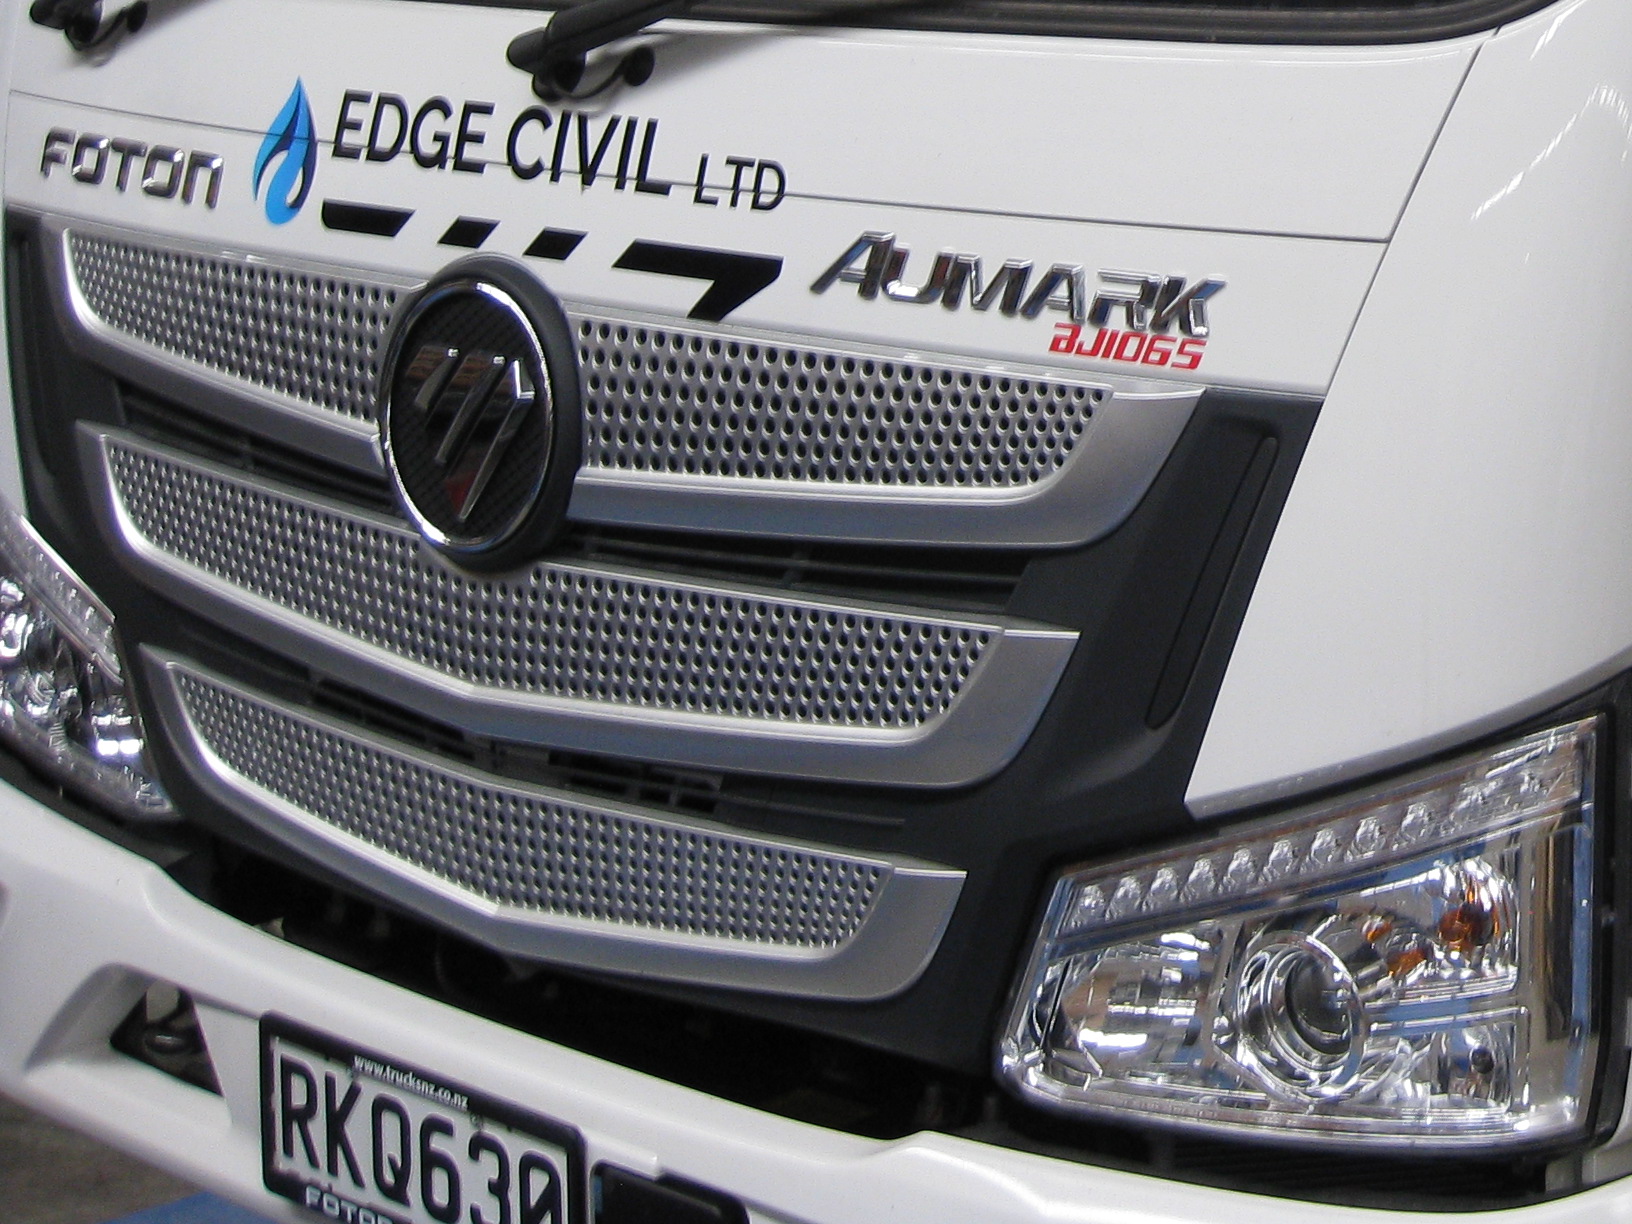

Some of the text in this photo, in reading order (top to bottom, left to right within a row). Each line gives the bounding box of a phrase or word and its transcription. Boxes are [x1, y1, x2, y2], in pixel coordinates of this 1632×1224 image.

[39, 128, 224, 209] FOTON
[331, 89, 787, 211] EDGE CIVIL LTD
[809, 230, 1227, 337] AUMARK
[353, 1054, 469, 1109] www.trucksnz.co.nz
[279, 1053, 563, 1224] RKQ630
[305, 1185, 396, 1224] FOTO
